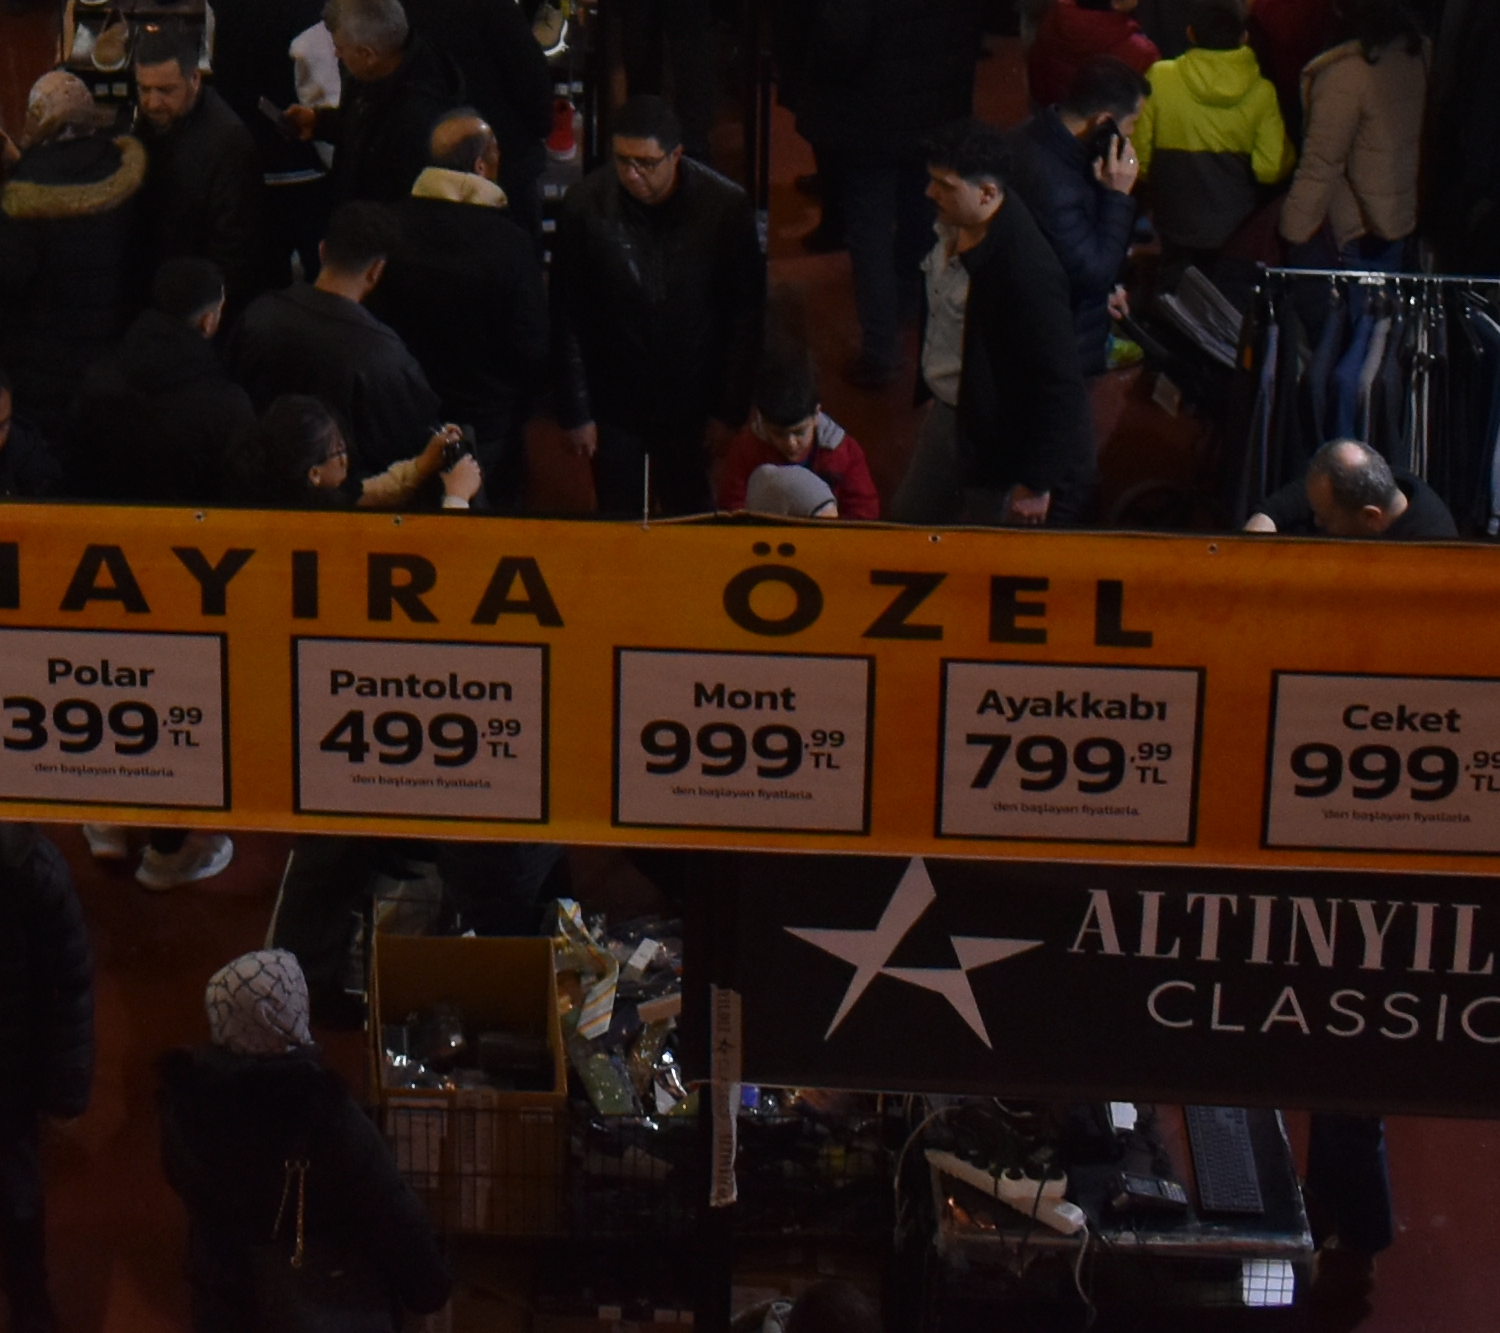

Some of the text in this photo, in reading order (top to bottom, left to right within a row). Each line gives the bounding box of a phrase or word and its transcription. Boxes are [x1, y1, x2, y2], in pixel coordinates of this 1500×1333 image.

[722, 541, 1152, 646] ÖZEL
[47, 658, 155, 688] Polar
[330, 669, 513, 702] Pantolon
[692, 681, 795, 711] Mont
[976, 689, 1167, 722] Ayakkabı
[1342, 704, 1461, 734] Ceket
[169, 730, 200, 747] TL
[487, 741, 517, 759] TL
[811, 751, 840, 770] TL
[1137, 765, 1167, 785] TL
[1471, 774, 1500, 793] TL
